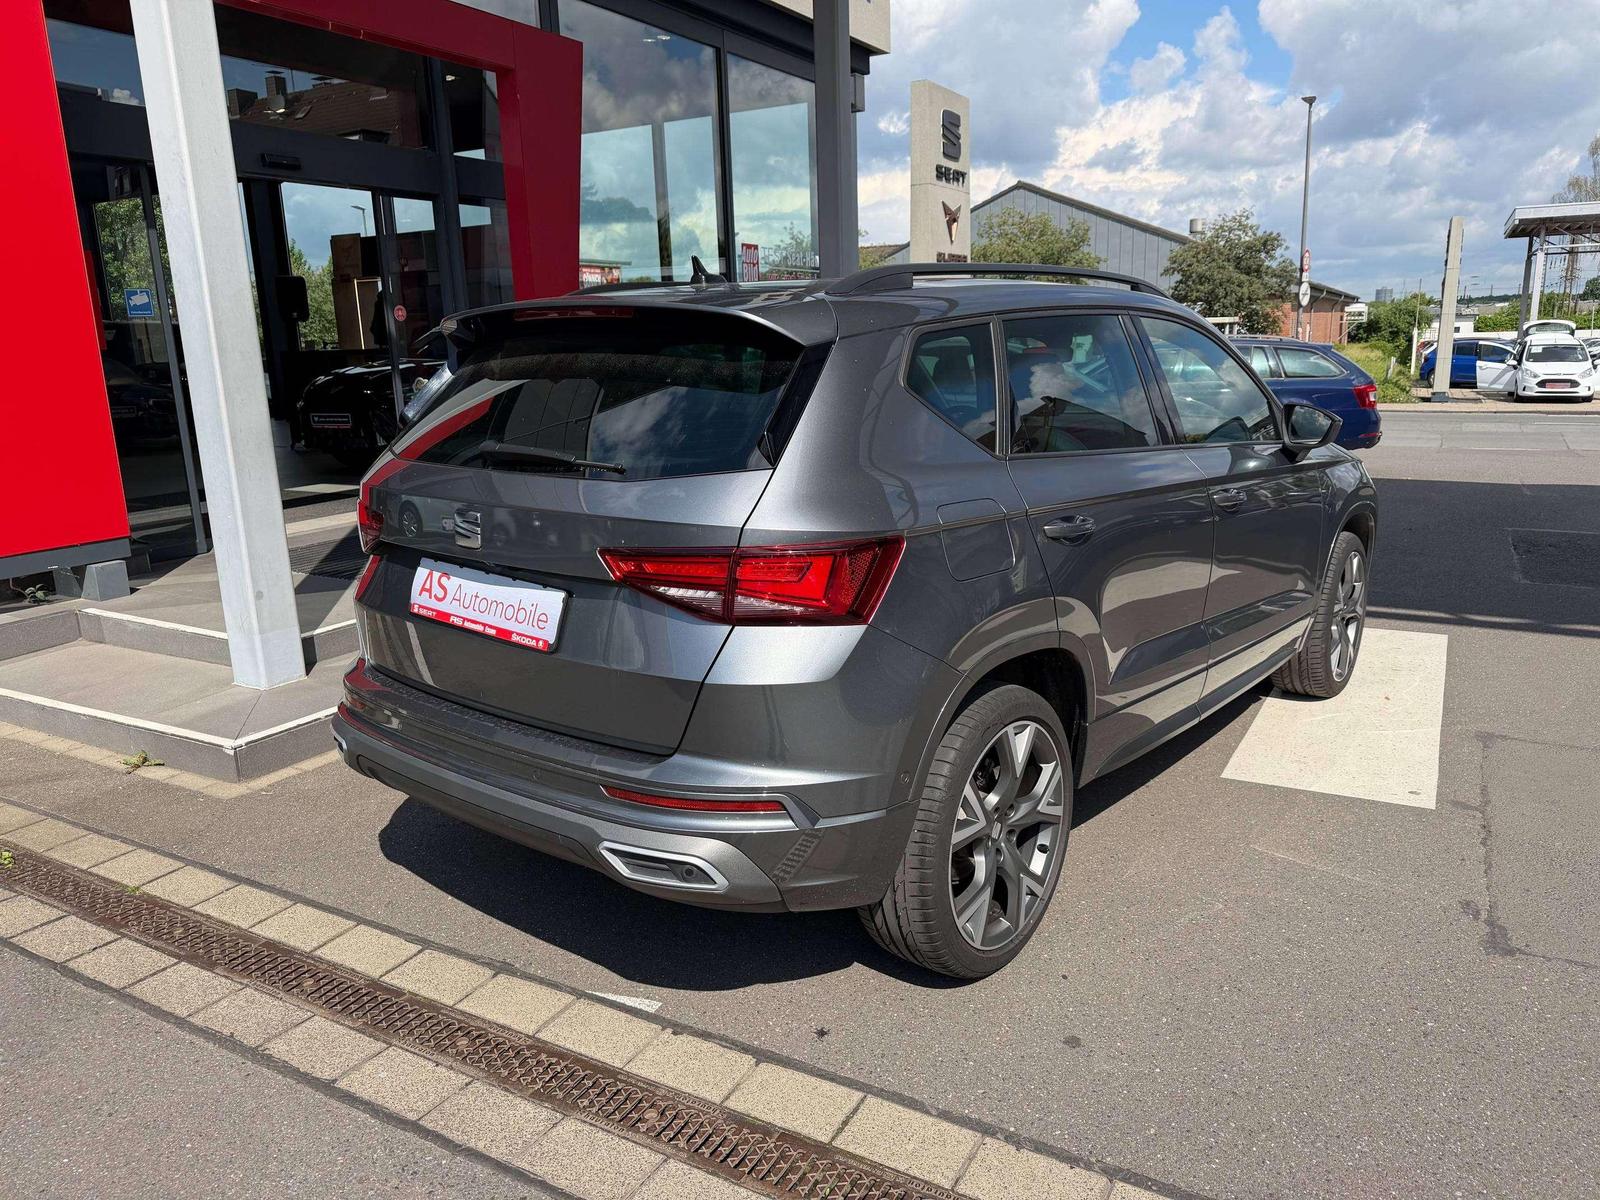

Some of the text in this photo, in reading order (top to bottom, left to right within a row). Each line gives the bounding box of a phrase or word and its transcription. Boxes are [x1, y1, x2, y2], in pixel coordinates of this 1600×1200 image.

[935, 164, 967, 187] SEAT
[742, 245, 759, 263] Auto
[418, 570, 450, 602] AS
[450, 584, 549, 630] Automobile
[511, 633, 537, 647] ŠKODA
